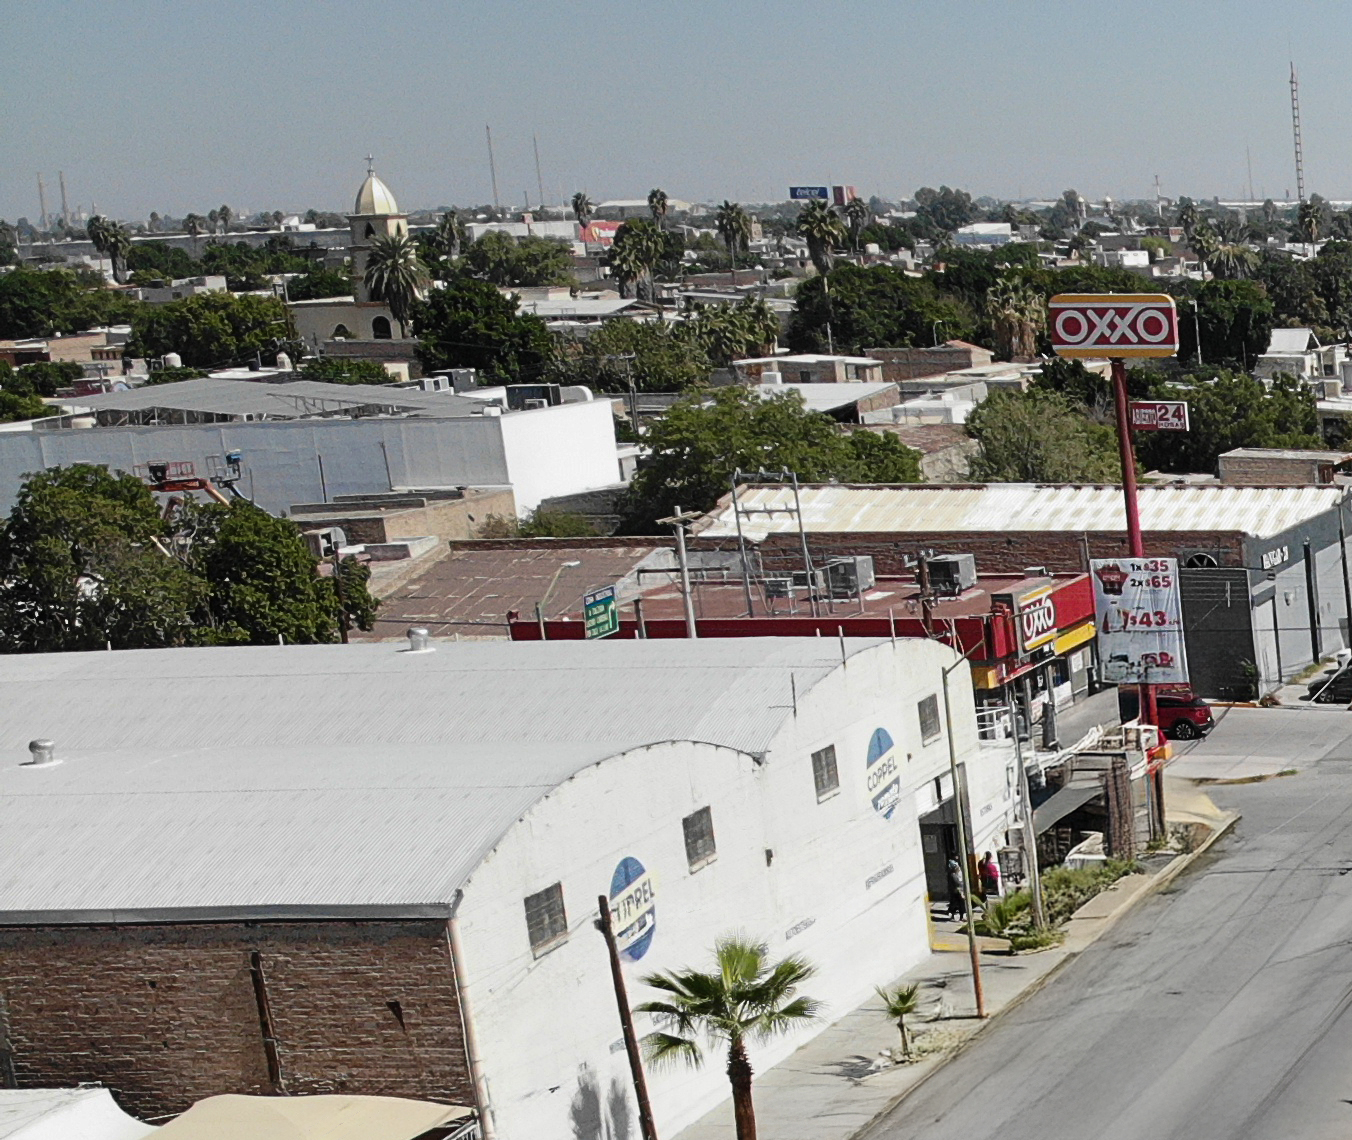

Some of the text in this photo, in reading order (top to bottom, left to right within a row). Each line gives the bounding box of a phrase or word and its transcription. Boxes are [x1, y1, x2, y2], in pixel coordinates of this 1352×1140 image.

[1055, 309, 1169, 343] OXXO
[1157, 405, 1184, 422] 24
[867, 756, 898, 792] COPPEL
